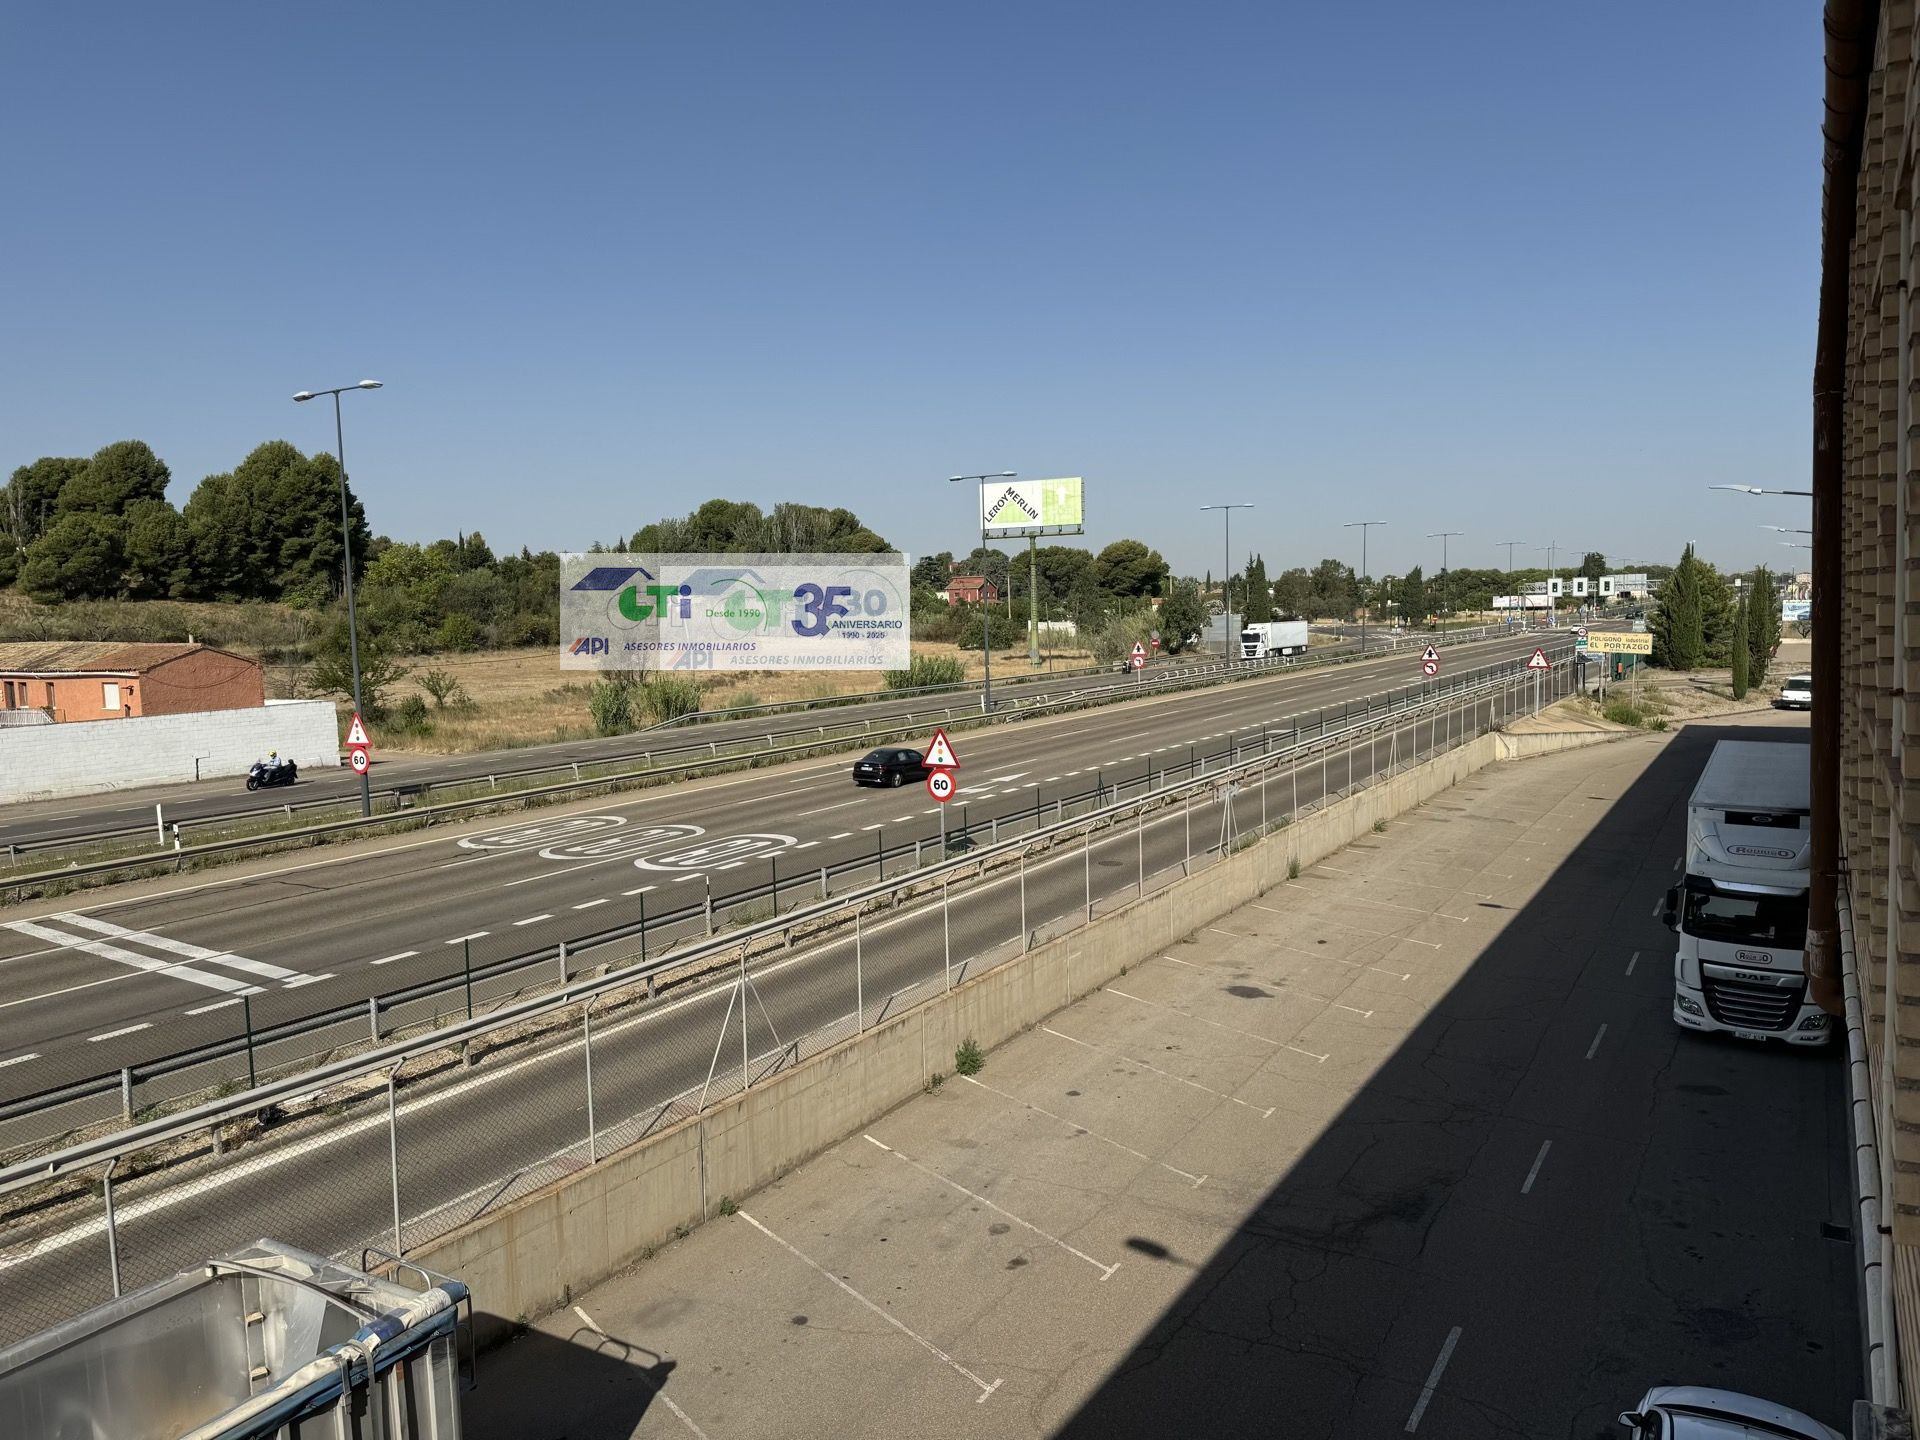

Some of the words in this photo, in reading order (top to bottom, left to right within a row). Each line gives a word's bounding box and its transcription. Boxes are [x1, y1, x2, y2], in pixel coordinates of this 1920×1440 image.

[984, 494, 1009, 523] LEROY
[1005, 486, 1039, 520] MERLIN
[353, 755, 365, 765] 60
[933, 779, 949, 791] 60
